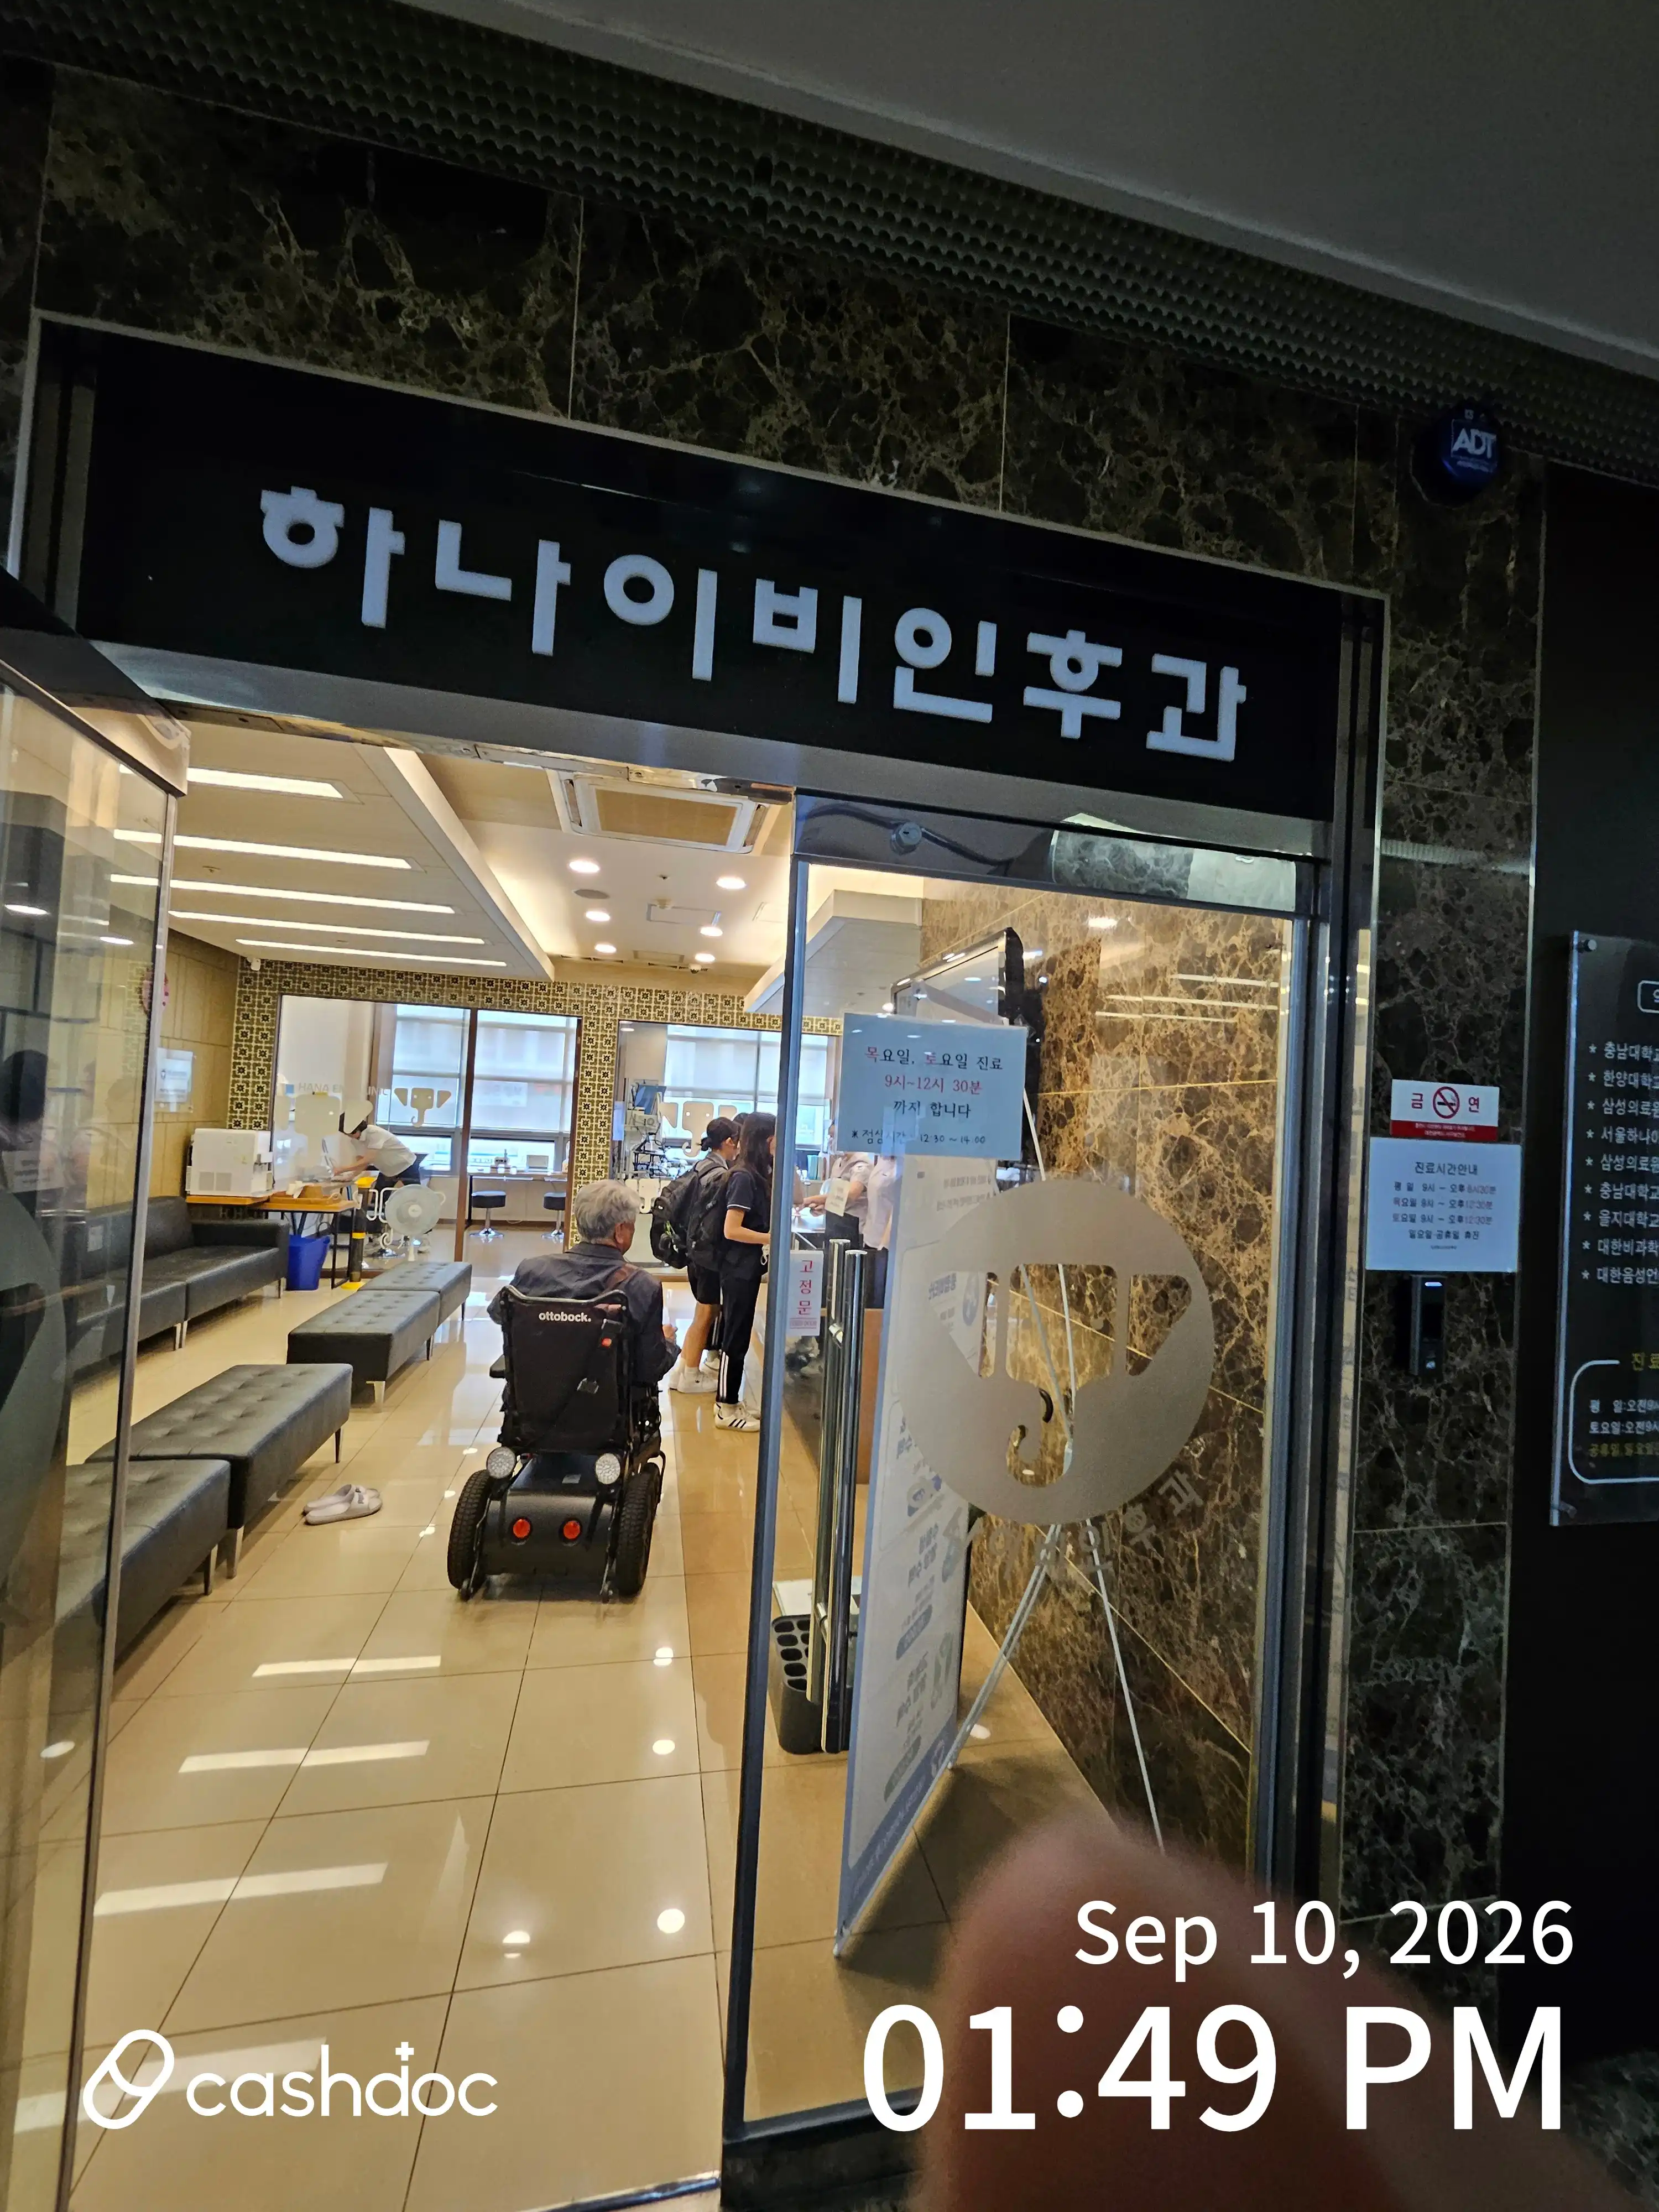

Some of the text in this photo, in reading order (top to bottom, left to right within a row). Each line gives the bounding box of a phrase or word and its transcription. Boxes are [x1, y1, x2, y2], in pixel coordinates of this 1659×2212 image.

[1452, 427, 1497, 459] ADT
[260, 486, 1246, 761] 하나이비인후과
[865, 1046, 915, 1065] 목요일,
[976, 1056, 1003, 1071] 진료
[884, 1074, 982, 1095] 9시~12시 30분
[894, 1099, 972, 1119] 까지 합니다
[1411, 1092, 1480, 1113] 금 연
[1415, 1161, 1478, 1176] 진료시간안내
[539, 1311, 591, 1322] ottobock.
